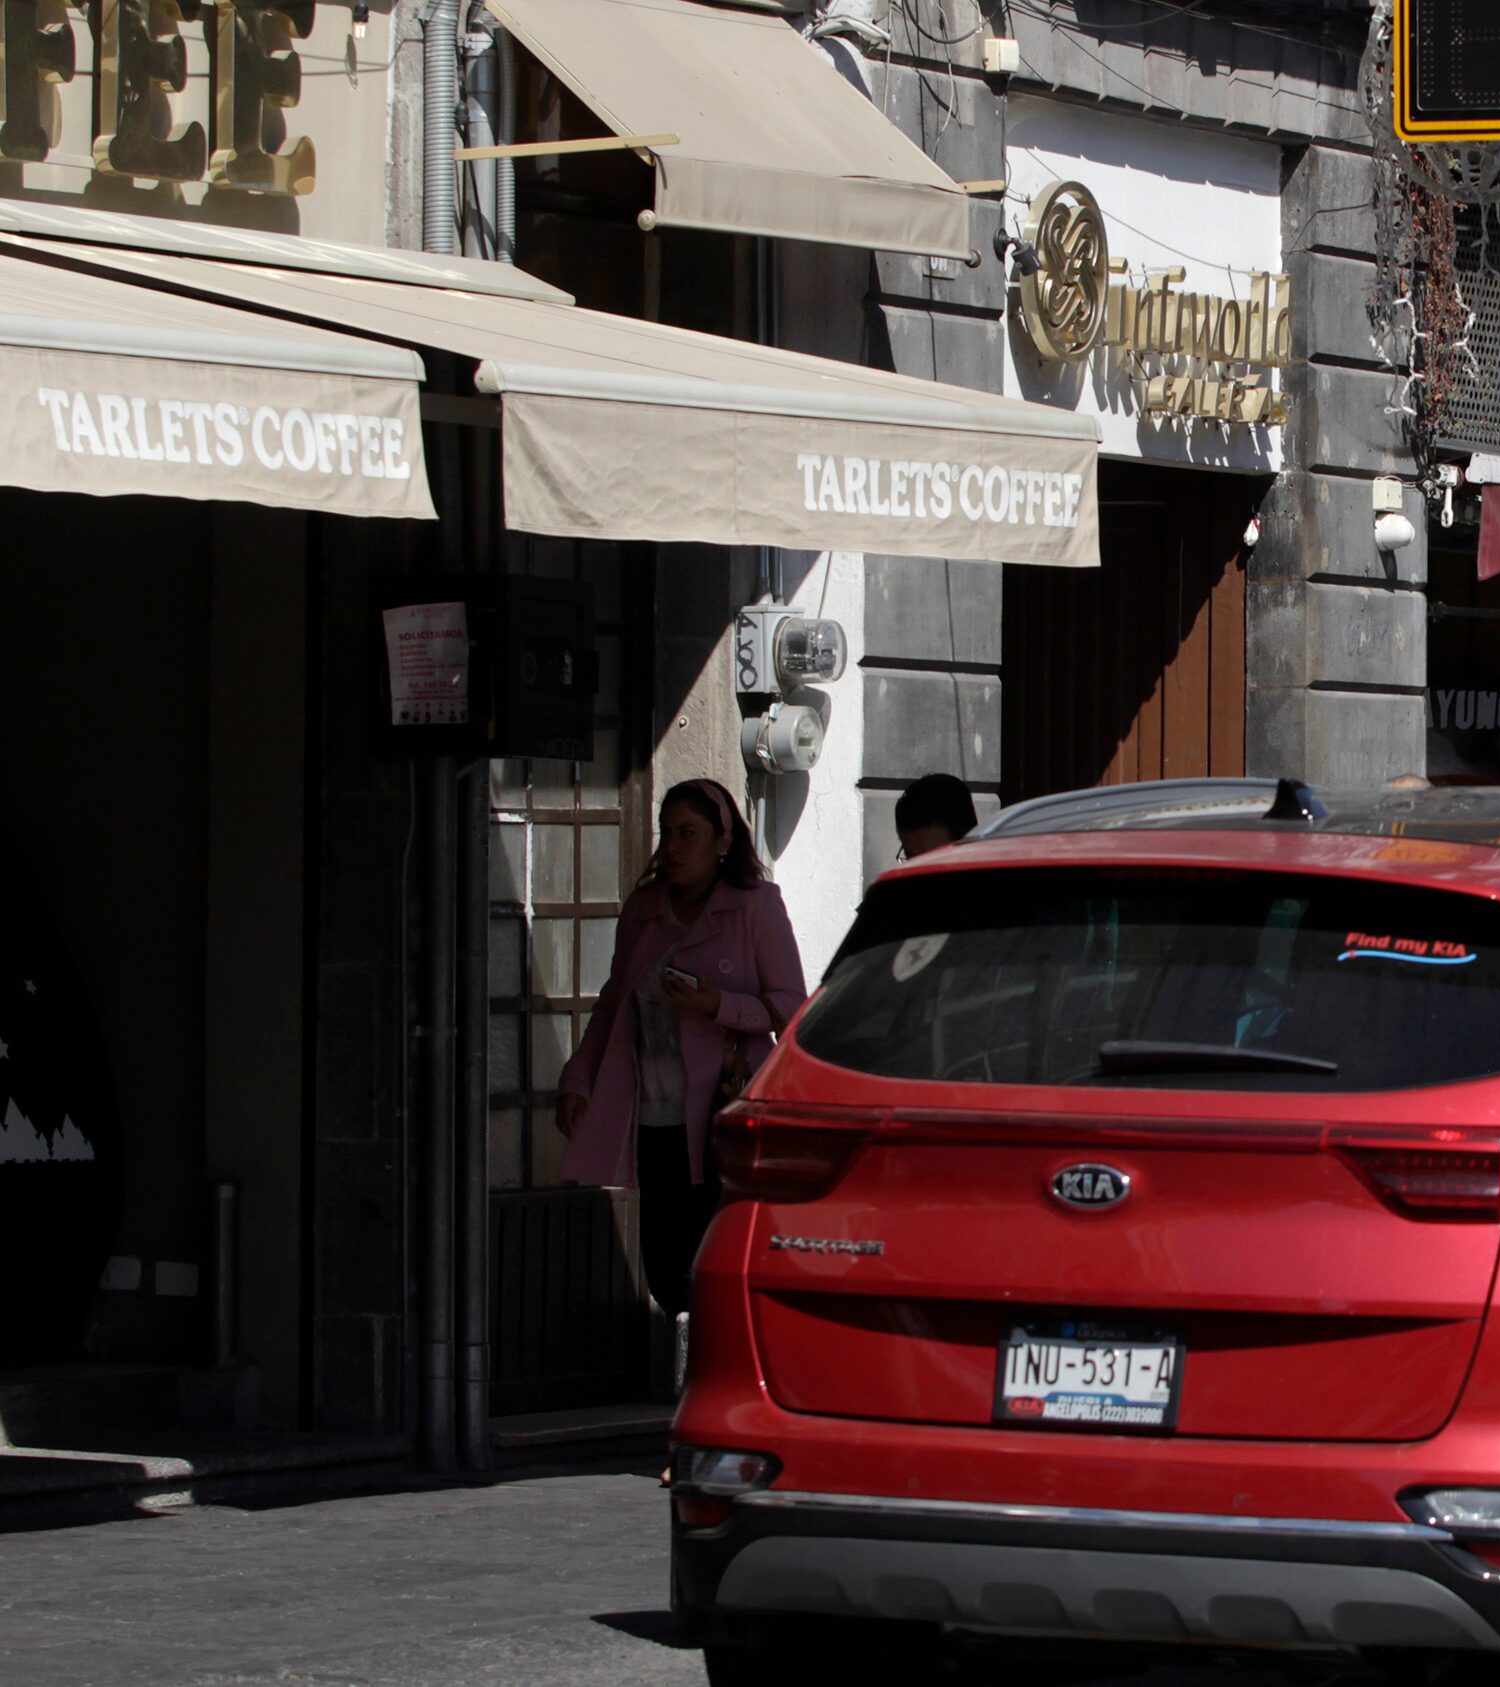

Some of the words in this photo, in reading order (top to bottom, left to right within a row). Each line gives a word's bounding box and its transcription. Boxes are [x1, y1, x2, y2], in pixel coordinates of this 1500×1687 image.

[252, 405, 411, 479] COFFEE
[959, 464, 1082, 528] COFFEE
[1345, 931, 1391, 949] Find
[1394, 938, 1427, 955] my
[1431, 941, 1466, 957] KIA
[1062, 1172, 1115, 1199] KIA
[1009, 1343, 1171, 1388] TNU-531-A
